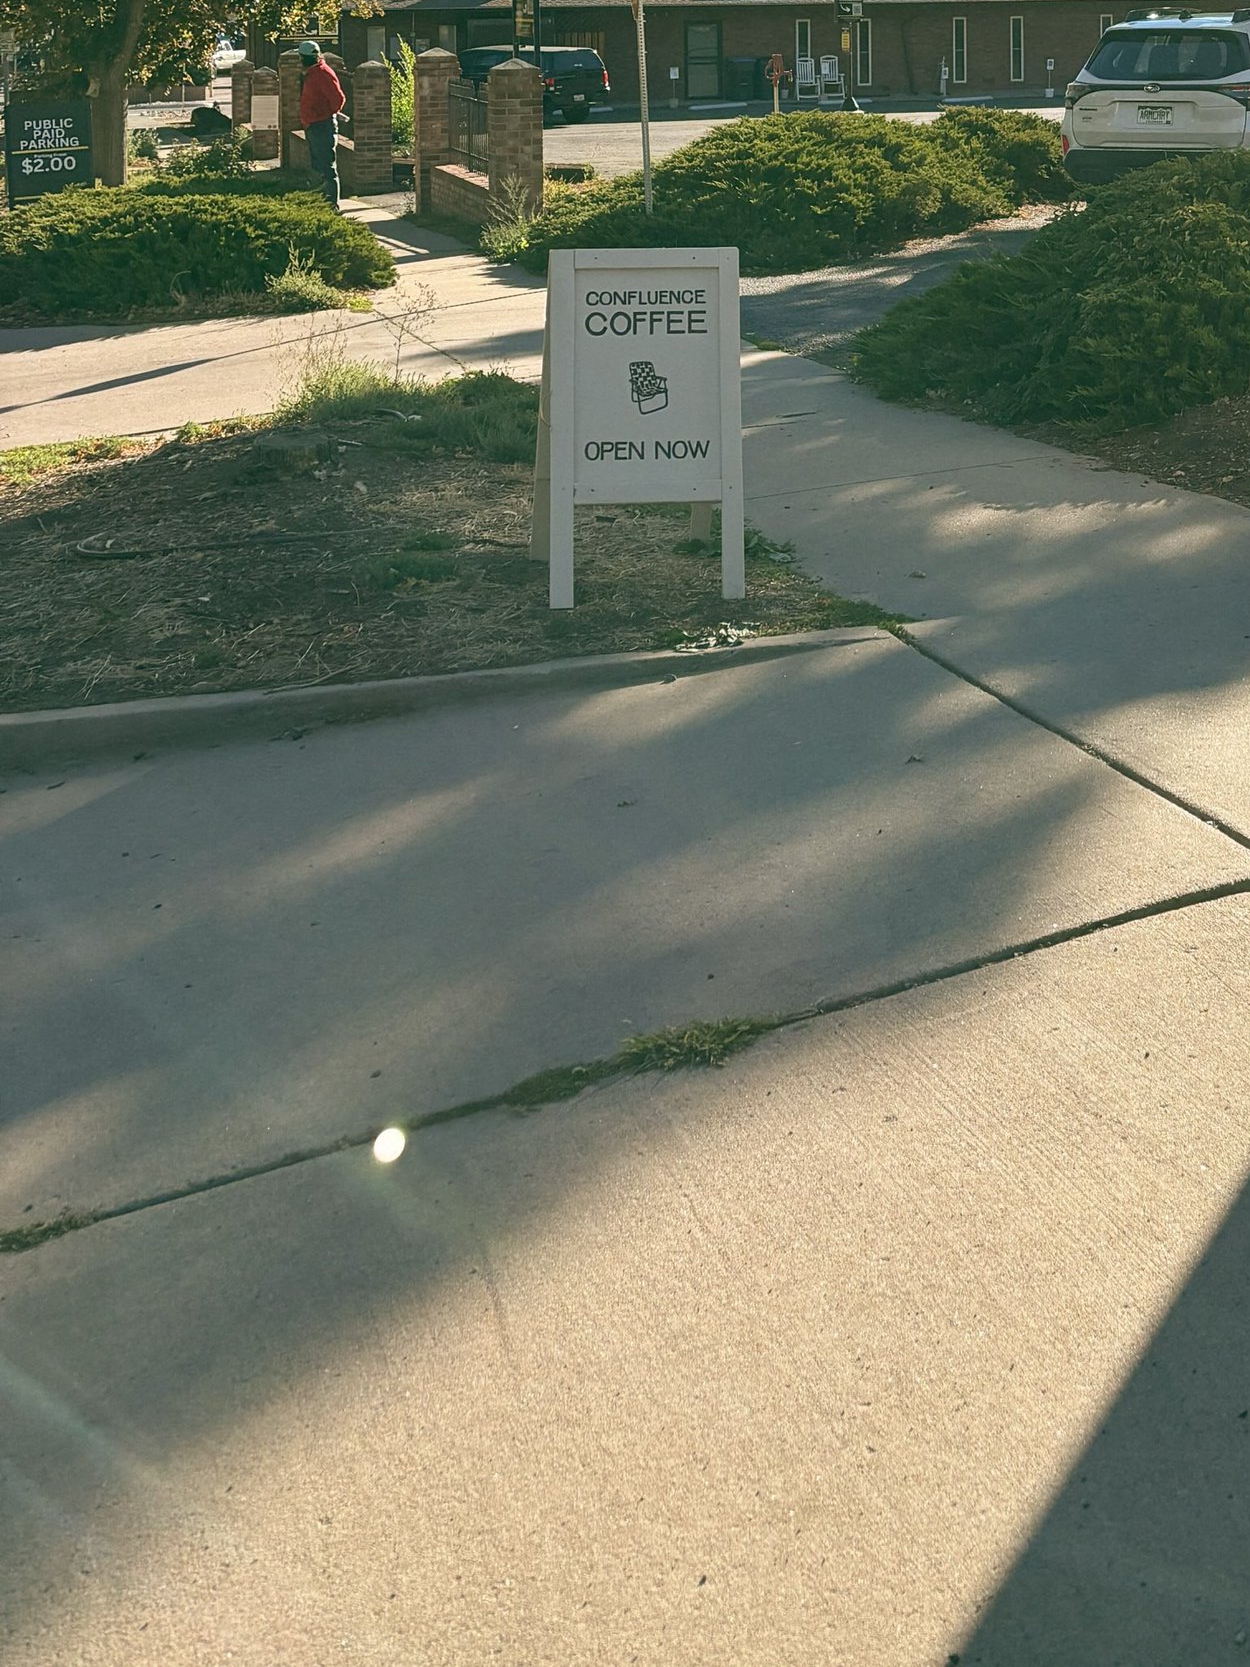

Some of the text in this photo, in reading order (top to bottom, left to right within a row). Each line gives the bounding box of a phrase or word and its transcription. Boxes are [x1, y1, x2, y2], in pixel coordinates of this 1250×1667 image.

[24, 118, 73, 130] PUBLIC
[33, 128, 65, 139] PAID
[20, 136, 79, 150] PARKING
[21, 156, 76, 175] $2.00
[585, 289, 707, 306] CONFLUENCE
[584, 310, 708, 337] COFFEE
[584, 439, 711, 461] OPEN NOW
